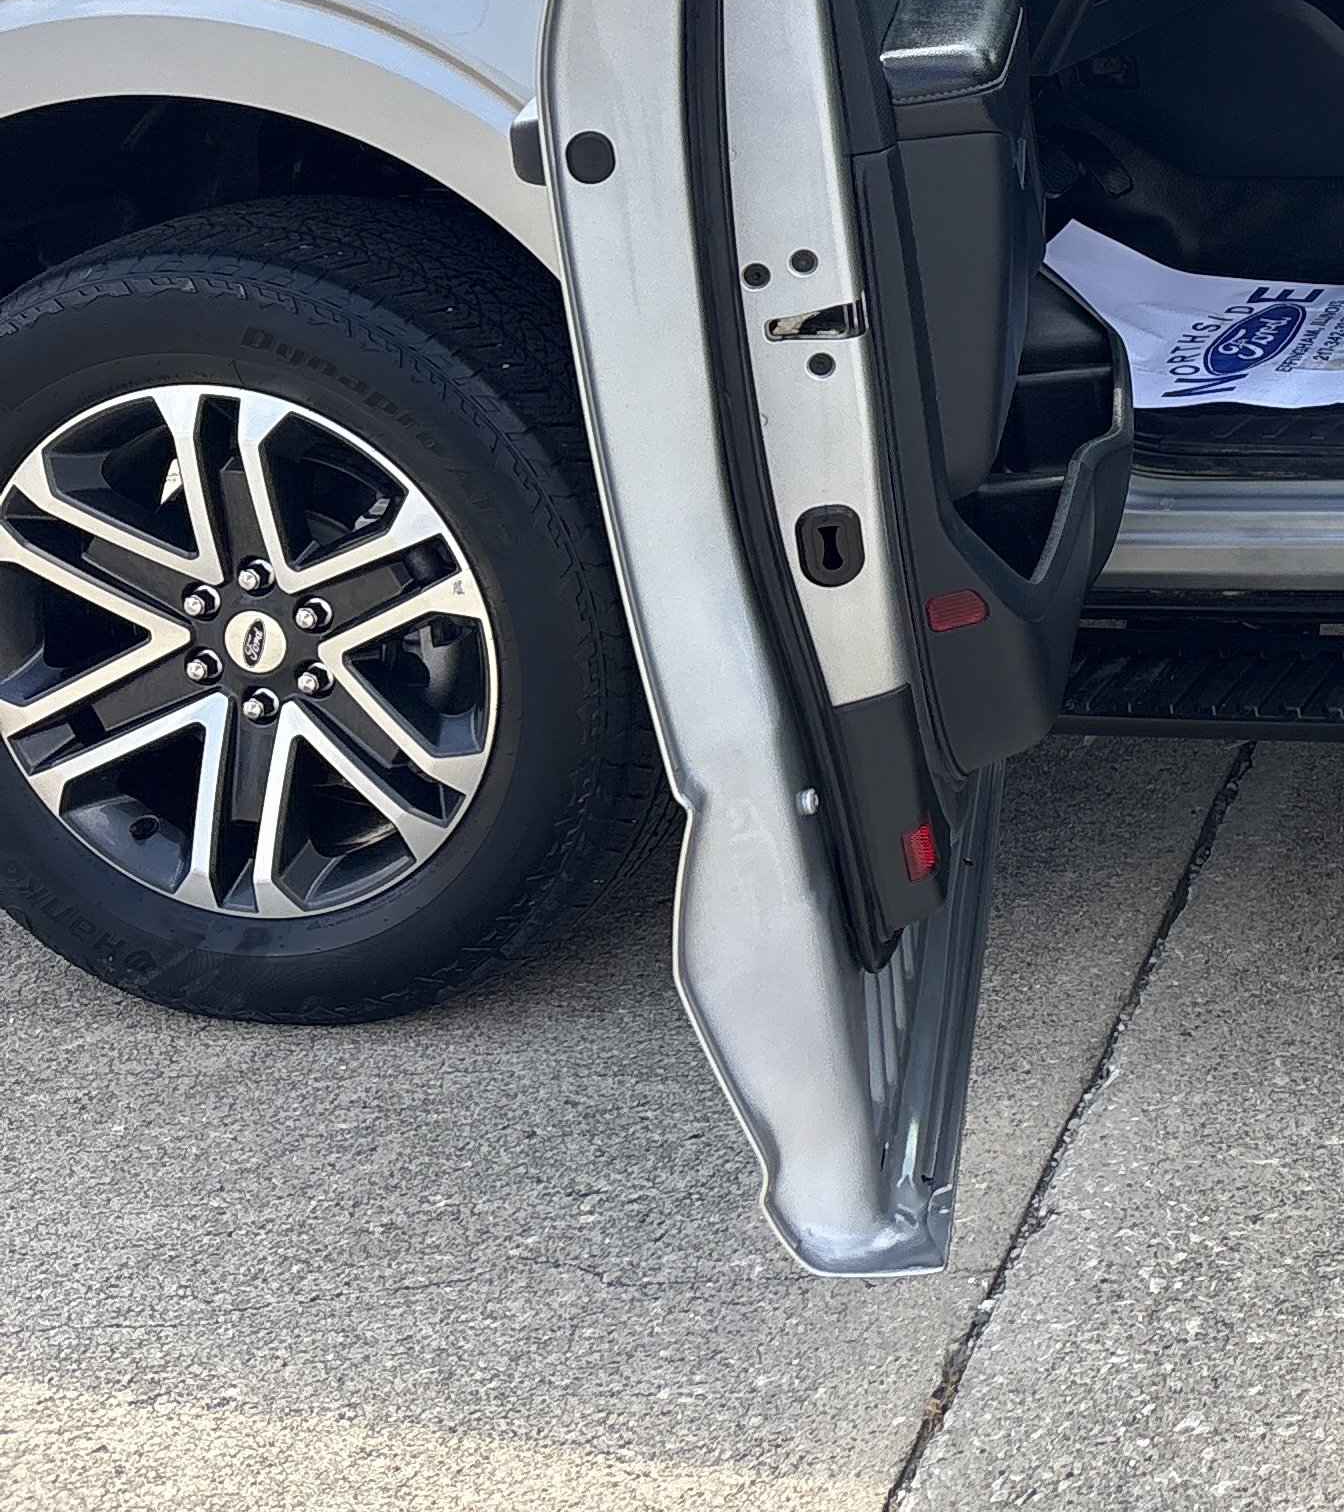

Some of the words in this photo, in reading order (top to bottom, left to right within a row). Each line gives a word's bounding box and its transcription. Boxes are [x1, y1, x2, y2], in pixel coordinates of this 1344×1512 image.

[1161, 286, 1325, 397] NORTHSIDE
[1217, 315, 1293, 361] Ford
[0, 857, 128, 956] Hanko
